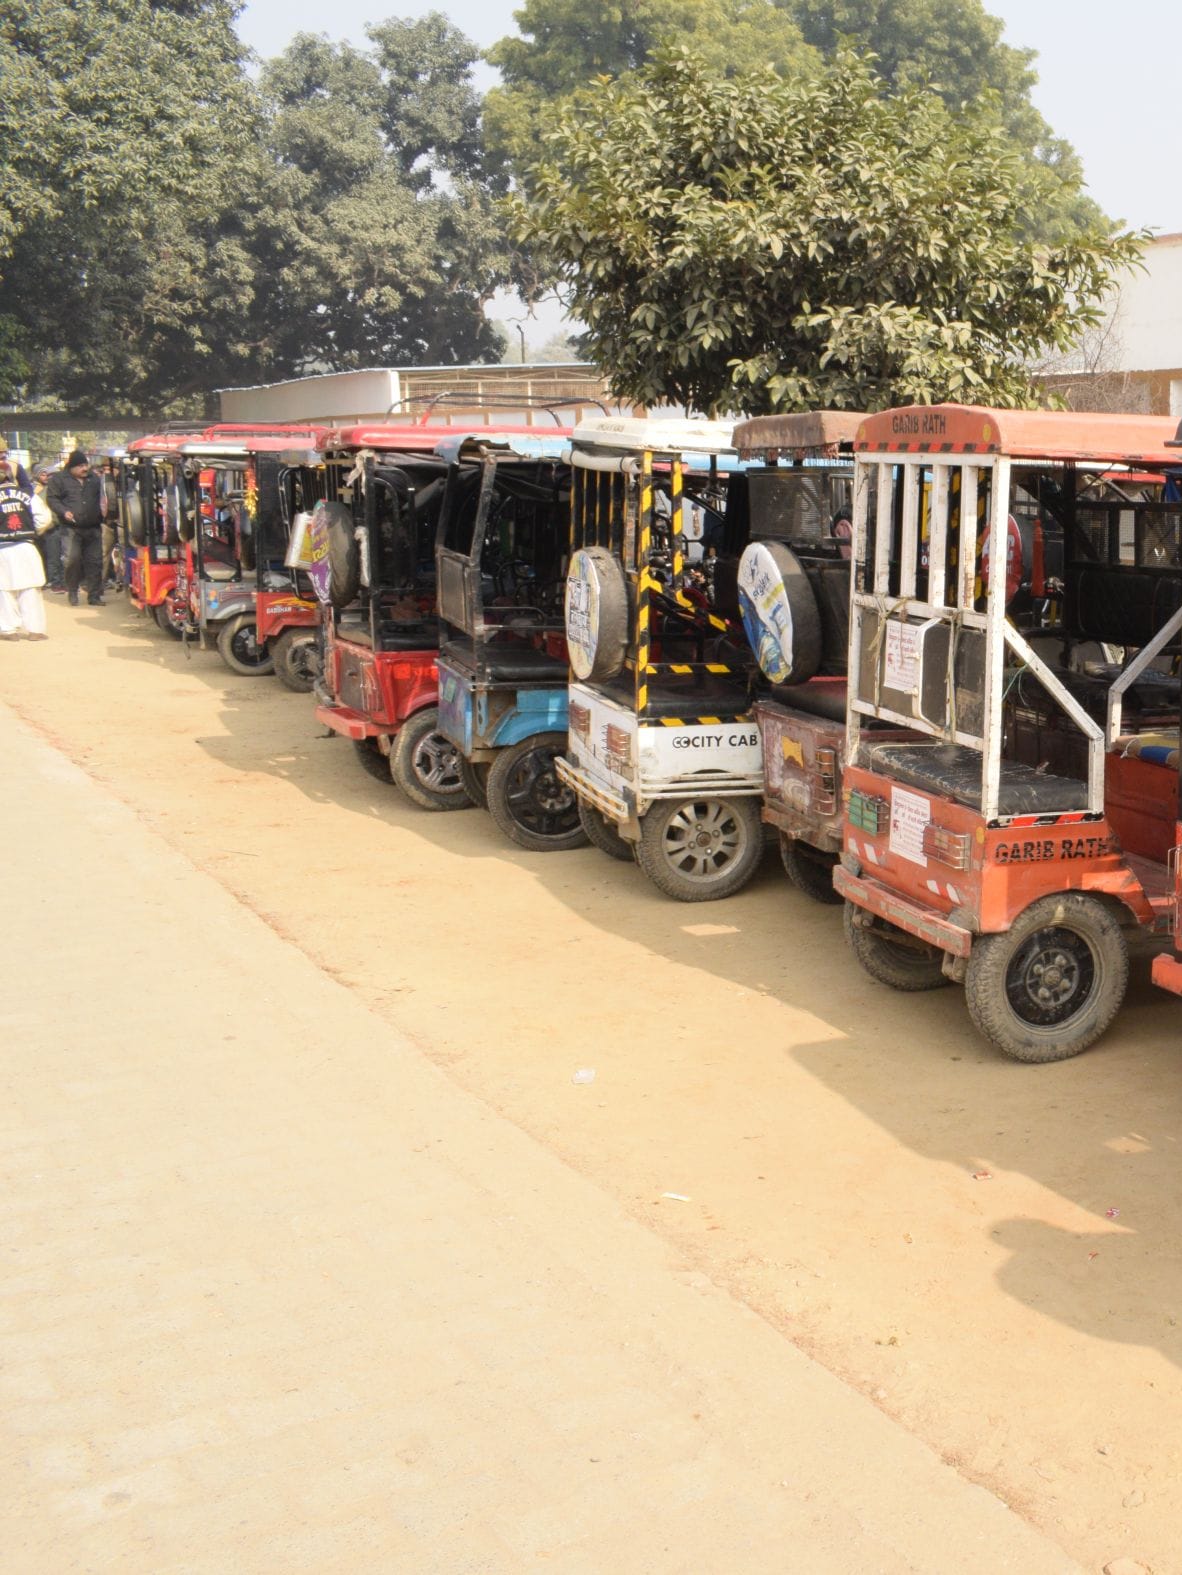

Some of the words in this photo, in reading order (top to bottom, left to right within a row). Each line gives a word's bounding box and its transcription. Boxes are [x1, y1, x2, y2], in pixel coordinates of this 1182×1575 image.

[892, 414, 919, 434] GARIB
[922, 414, 946, 434] RATH
[691, 736, 723, 748] CITY
[728, 735, 758, 747] CAB
[995, 841, 1055, 863] GARIB
